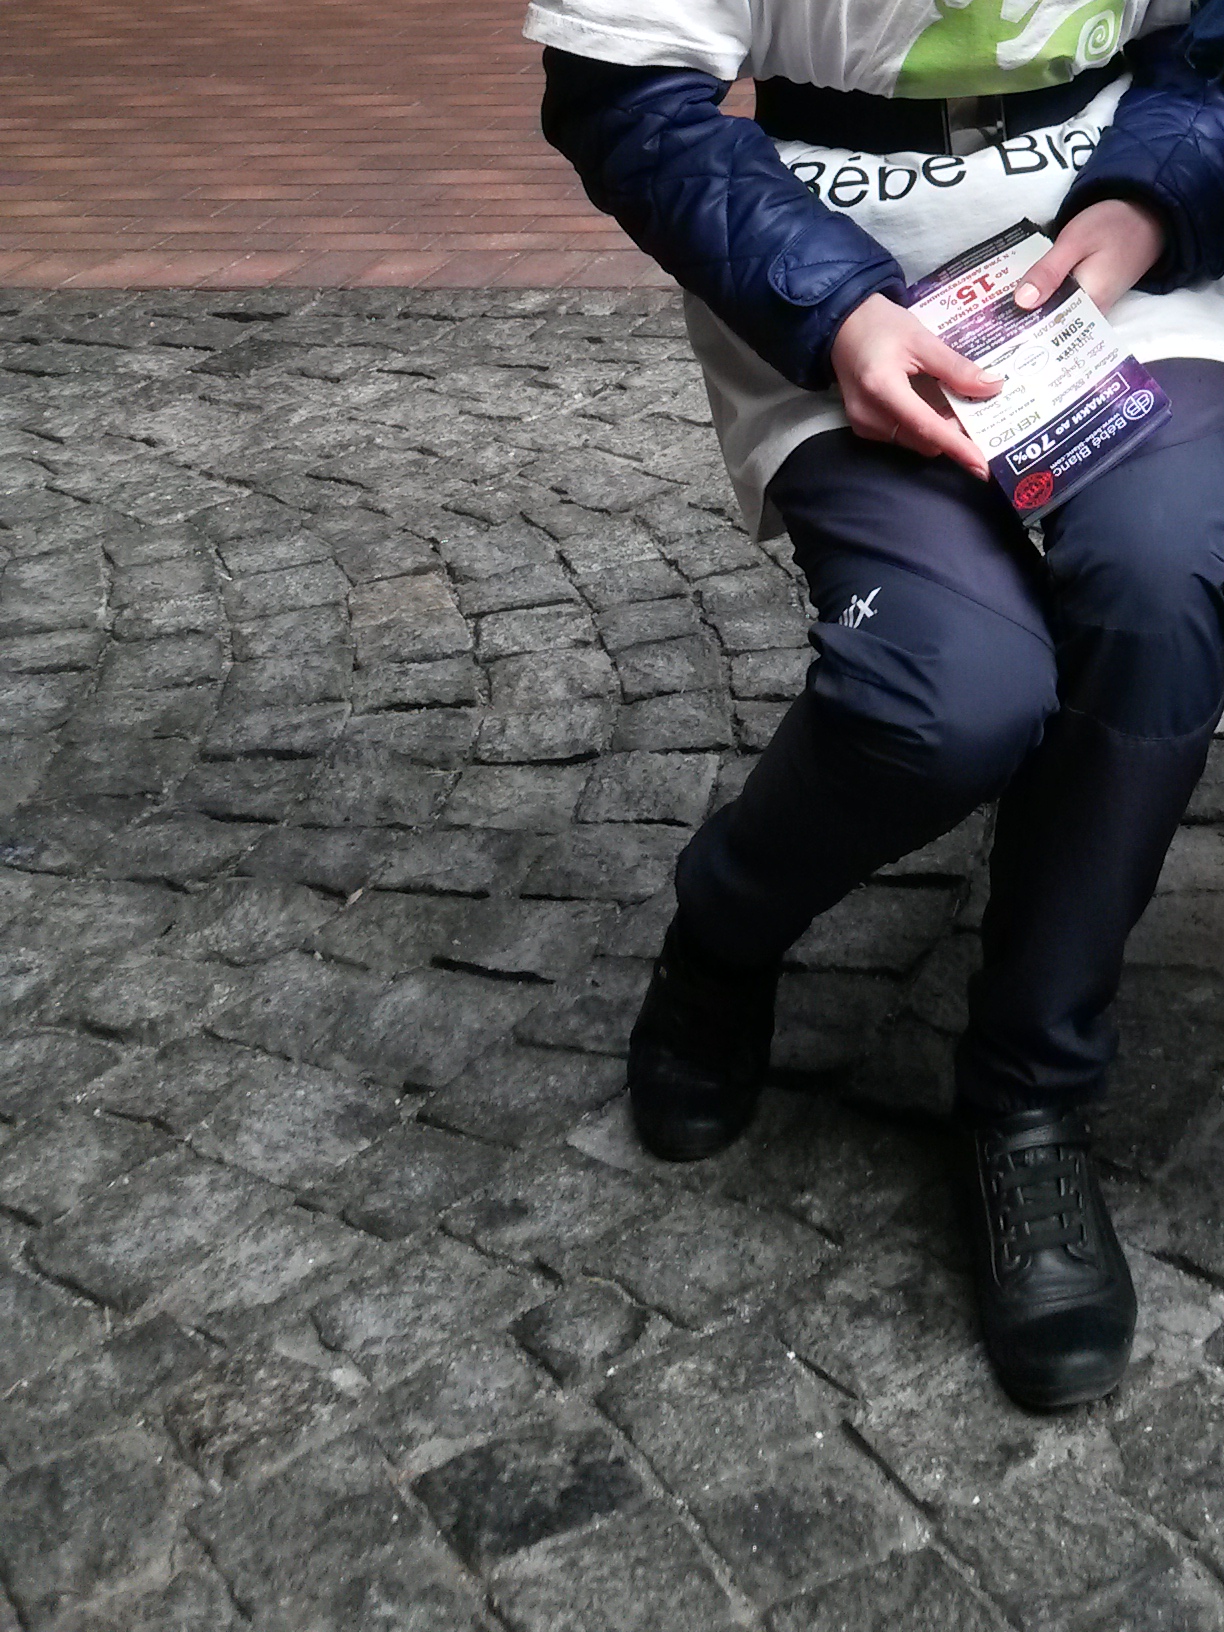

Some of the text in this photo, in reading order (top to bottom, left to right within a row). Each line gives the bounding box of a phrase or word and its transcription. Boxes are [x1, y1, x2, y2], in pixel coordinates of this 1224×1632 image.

[1049, 316, 1084, 347] SONIA
[989, 411, 1041, 447] KENZO
[1010, 432, 1056, 465] 70%
[1050, 415, 1127, 478] Bébé Blanc
